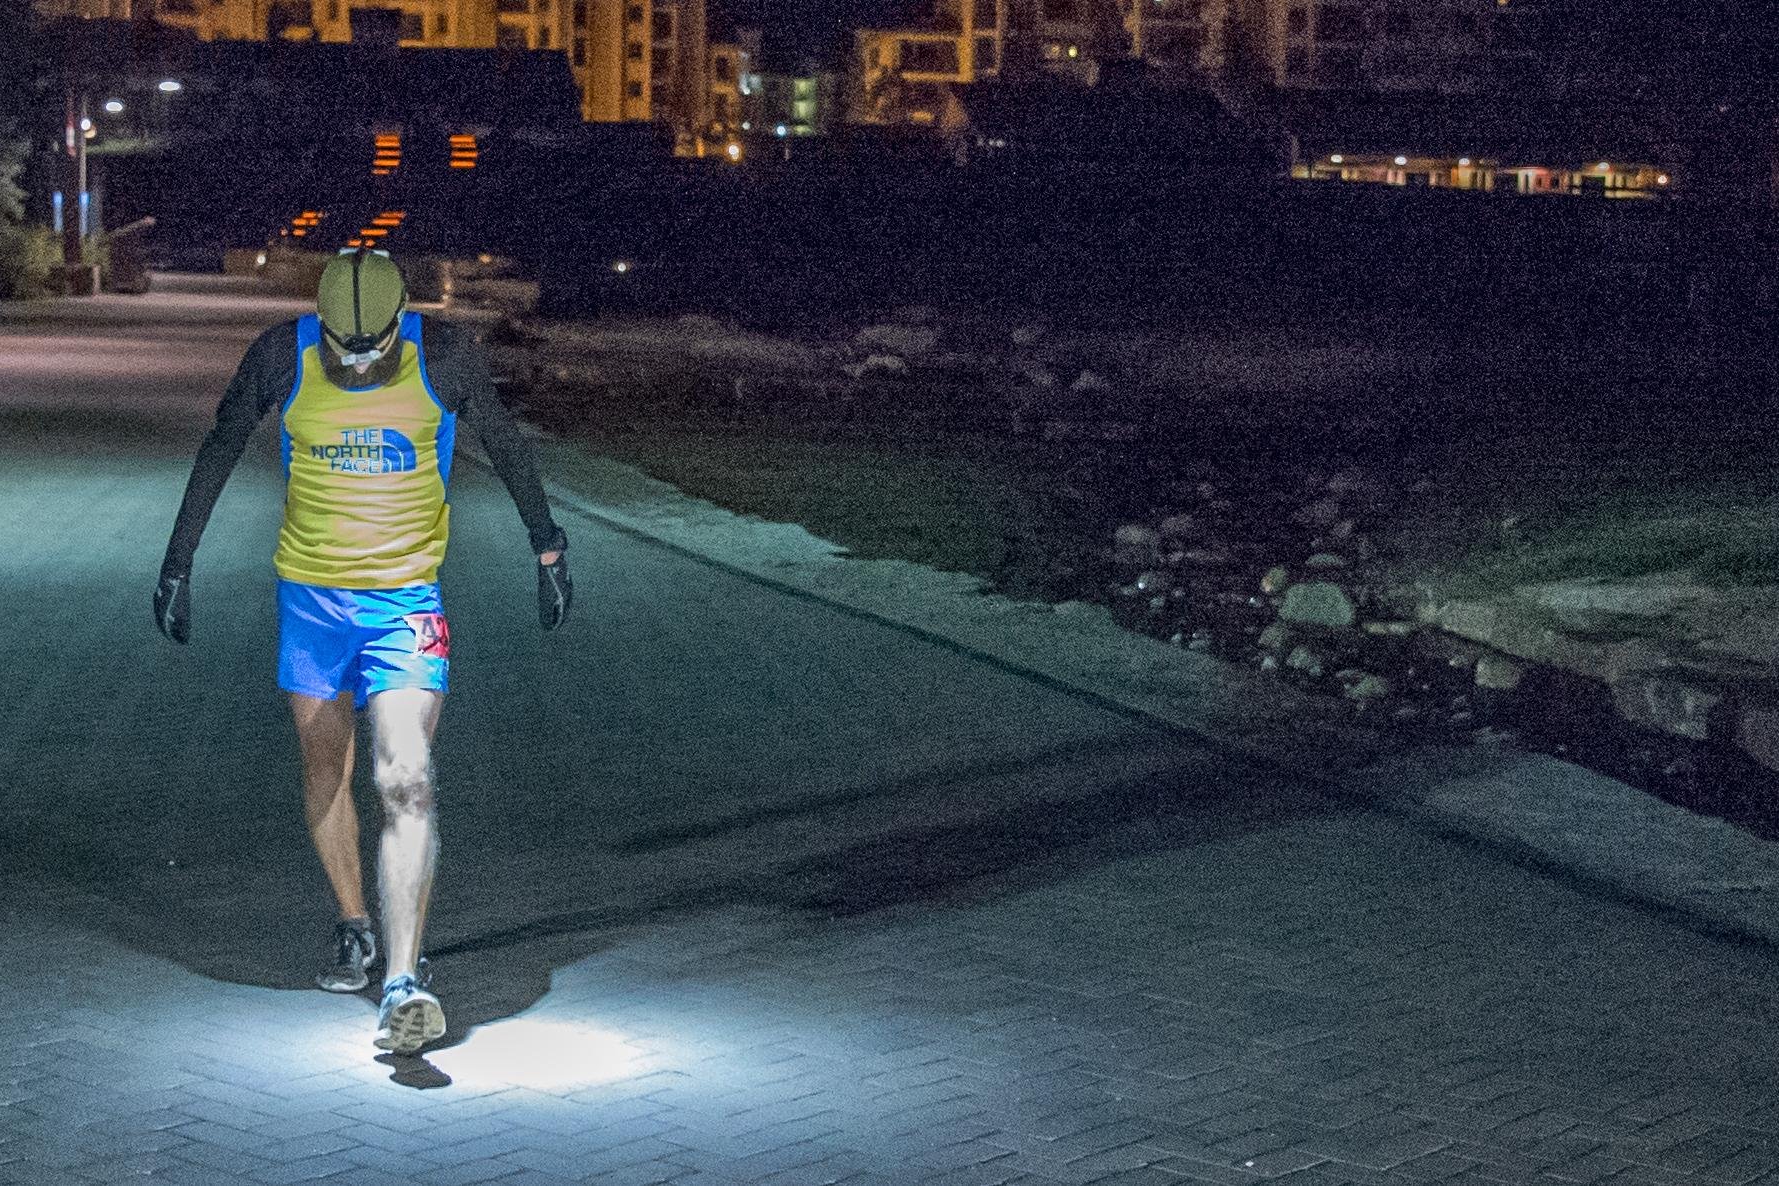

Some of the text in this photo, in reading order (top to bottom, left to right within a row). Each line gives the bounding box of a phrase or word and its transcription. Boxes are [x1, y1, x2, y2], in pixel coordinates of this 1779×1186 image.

[340, 428, 381, 445] THE
[310, 445, 382, 460] NORTH
[330, 459, 381, 474] FACE
